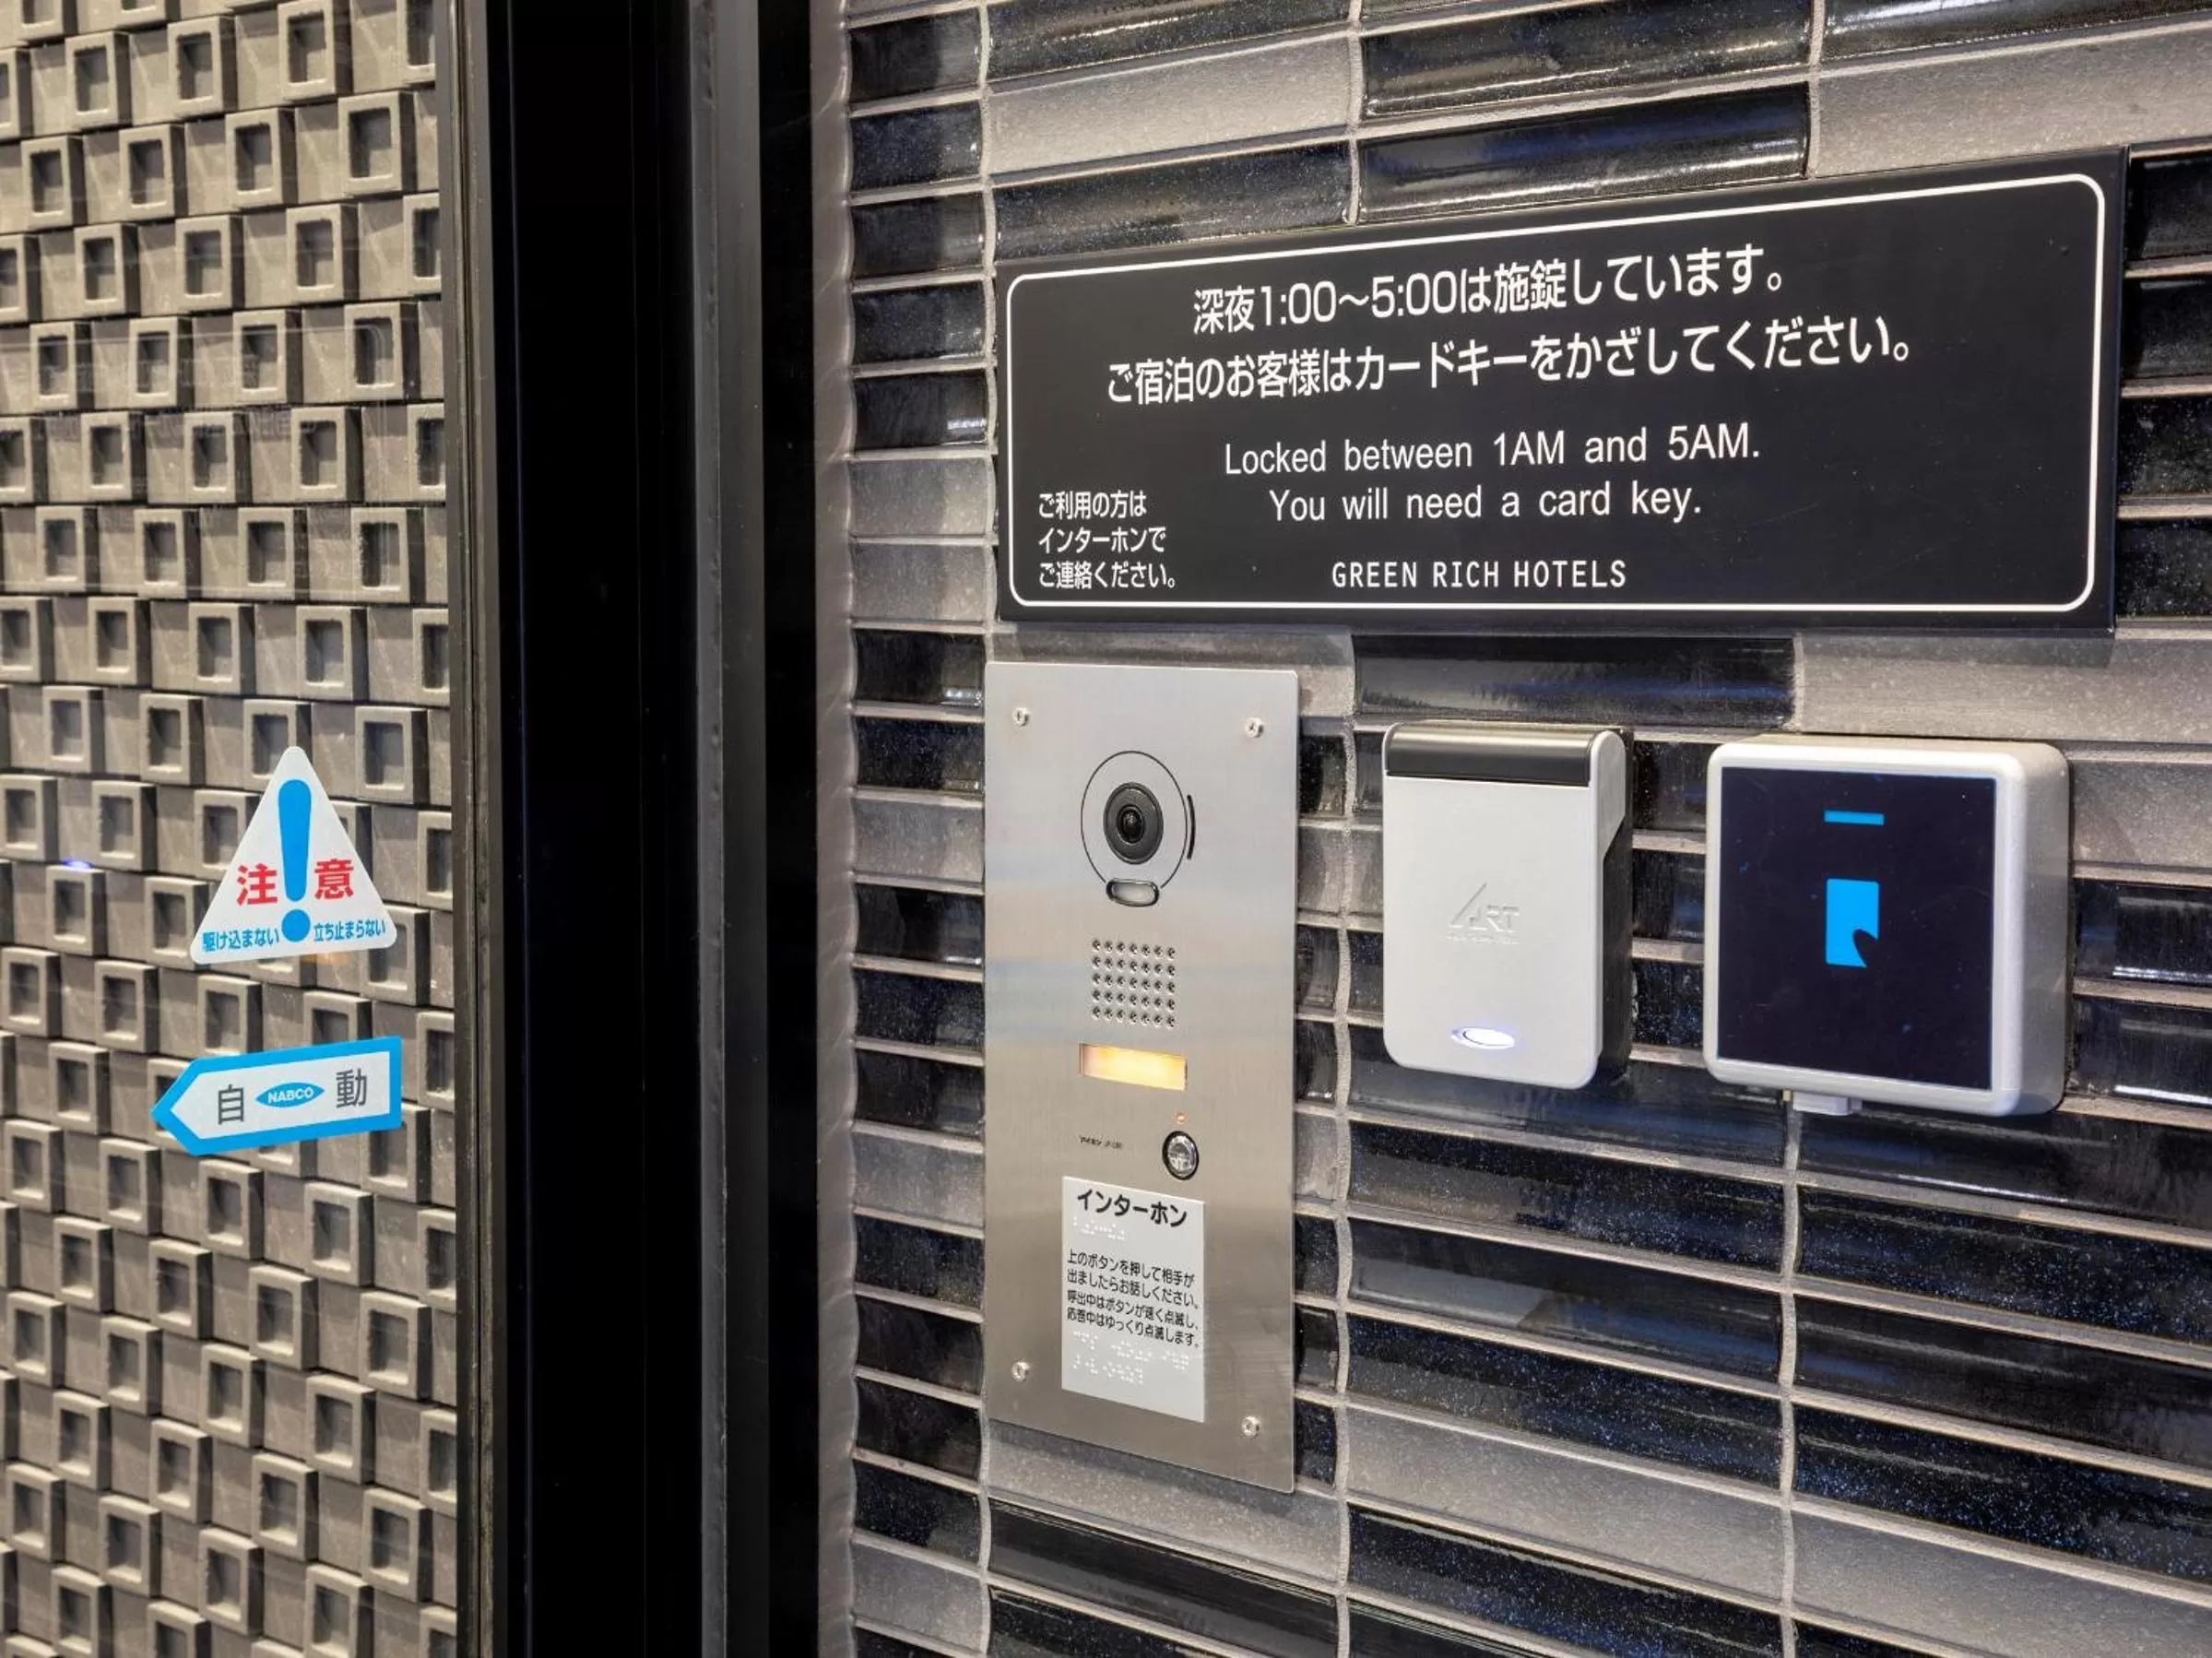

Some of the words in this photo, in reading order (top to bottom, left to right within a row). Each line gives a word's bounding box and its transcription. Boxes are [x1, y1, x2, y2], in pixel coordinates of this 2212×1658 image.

[1107, 315, 1910, 406] ご宿泊のお客様はカードキーをかざしてください。
[1225, 440, 1327, 475] Locked
[1343, 437, 1473, 472] between
[1494, 430, 1565, 467] 1AM
[1585, 427, 1647, 465] and
[1668, 422, 1759, 461] 5AM.
[1038, 490, 1148, 521] ご利用の方は
[1268, 488, 1326, 522] You
[1341, 486, 1389, 520] will
[1406, 484, 1483, 519] need
[1500, 491, 1521, 517] a
[1538, 480, 1611, 517] card
[1631, 480, 1701, 524] key.
[1038, 526, 1166, 554] インターホンで
[1038, 560, 1176, 590] ご連絡ください。
[1331, 561, 1417, 588] GREEN
[1432, 560, 1499, 588] RICH
[1513, 559, 1626, 588] HOTELS
[202, 927, 279, 952] 駆け込まない
[313, 919, 385, 942] 立ち止まらない
[267, 1086, 314, 1104] NABCO
[1077, 1188, 1188, 1228] インターホン
[1067, 1249, 1196, 1288] 上のボタンを押して相手が
